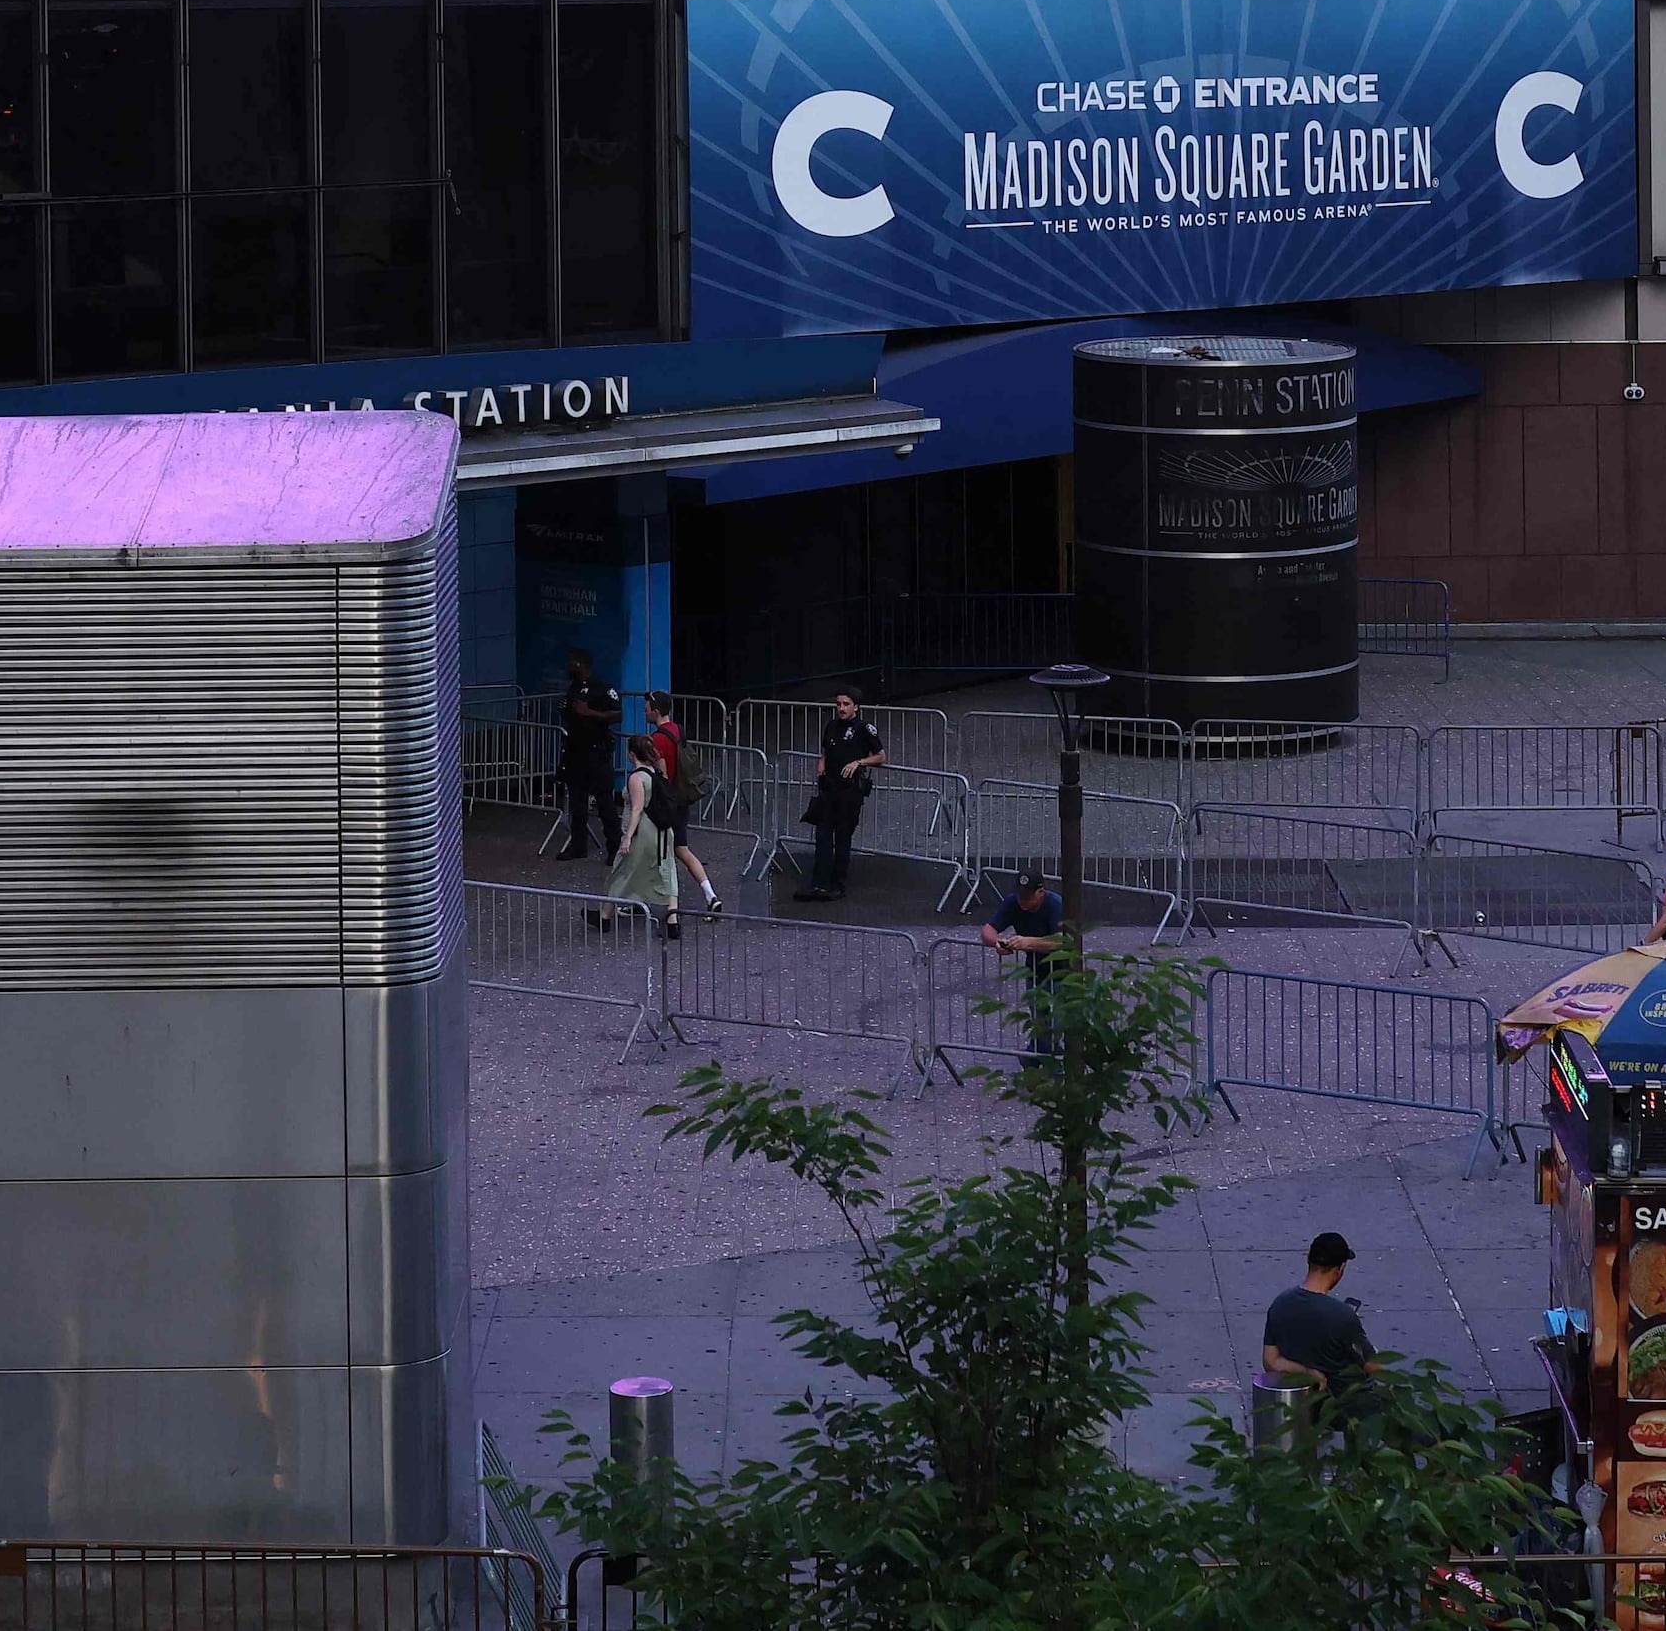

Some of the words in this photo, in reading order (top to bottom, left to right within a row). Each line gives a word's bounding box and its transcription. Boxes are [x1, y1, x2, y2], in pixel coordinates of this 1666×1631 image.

[1036, 80, 1148, 113] CHASE
[1194, 73, 1379, 109] ENTRANCE
[1495, 70, 1584, 199] C
[772, 89, 895, 237] C
[1042, 217, 1078, 234] THE
[1086, 211, 1171, 232] WORLD'S
[1179, 211, 1228, 229] MOST
[1237, 207, 1307, 225] FAMOUS
[414, 376, 630, 427] STATION
[1276, 367, 1355, 415] STATION
[570, 602, 598, 617] HALL
[1548, 981, 1630, 1004] SABRETT
[1608, 1060, 1641, 1073] WE'RE
[1643, 1061, 1659, 1074] ON
